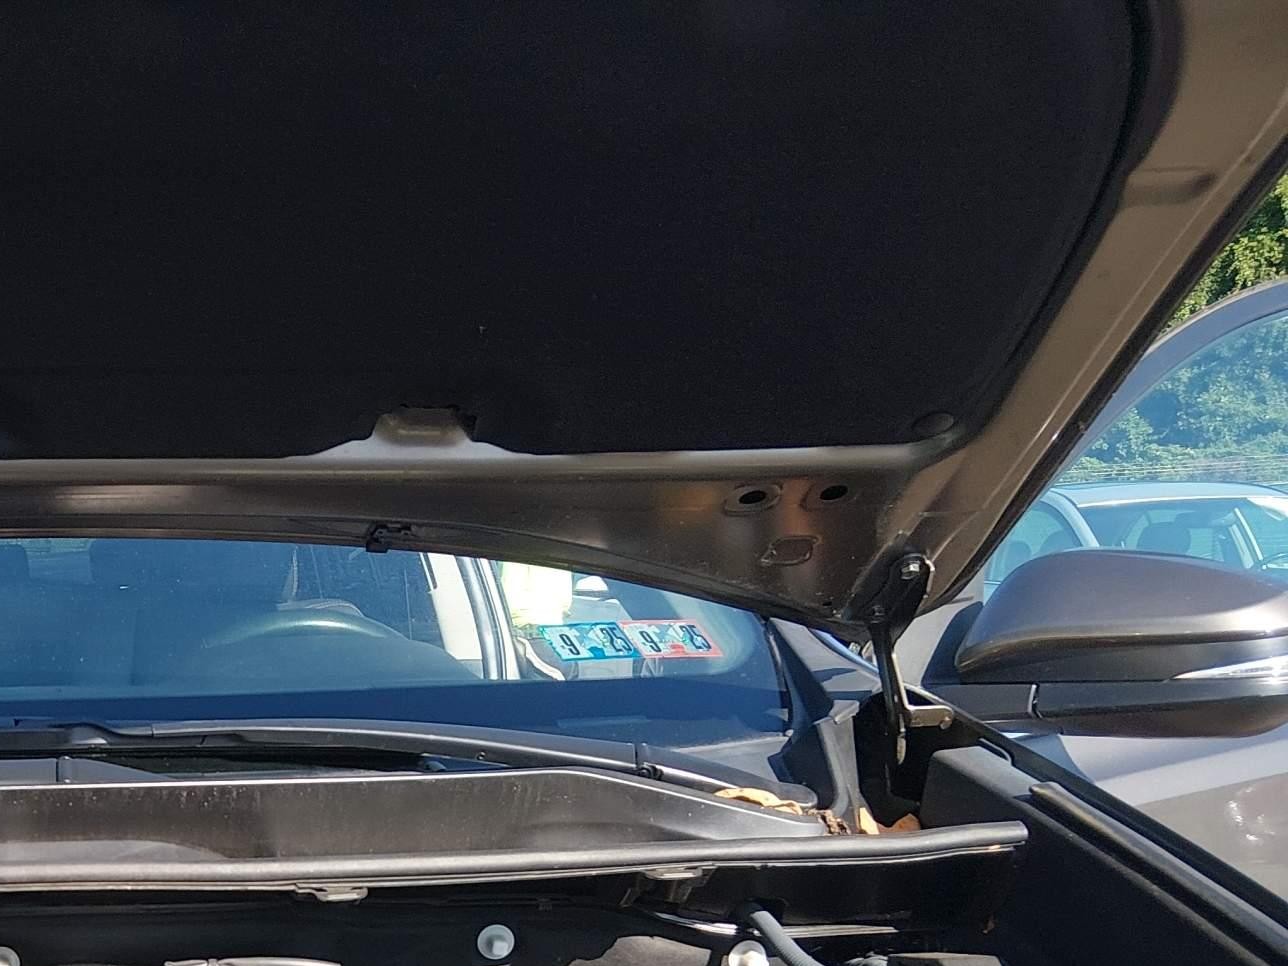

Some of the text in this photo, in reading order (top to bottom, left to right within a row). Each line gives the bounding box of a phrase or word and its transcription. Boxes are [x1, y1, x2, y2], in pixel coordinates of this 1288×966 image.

[559, 626, 633, 656] 9 25
[639, 624, 713, 653] 9 25
